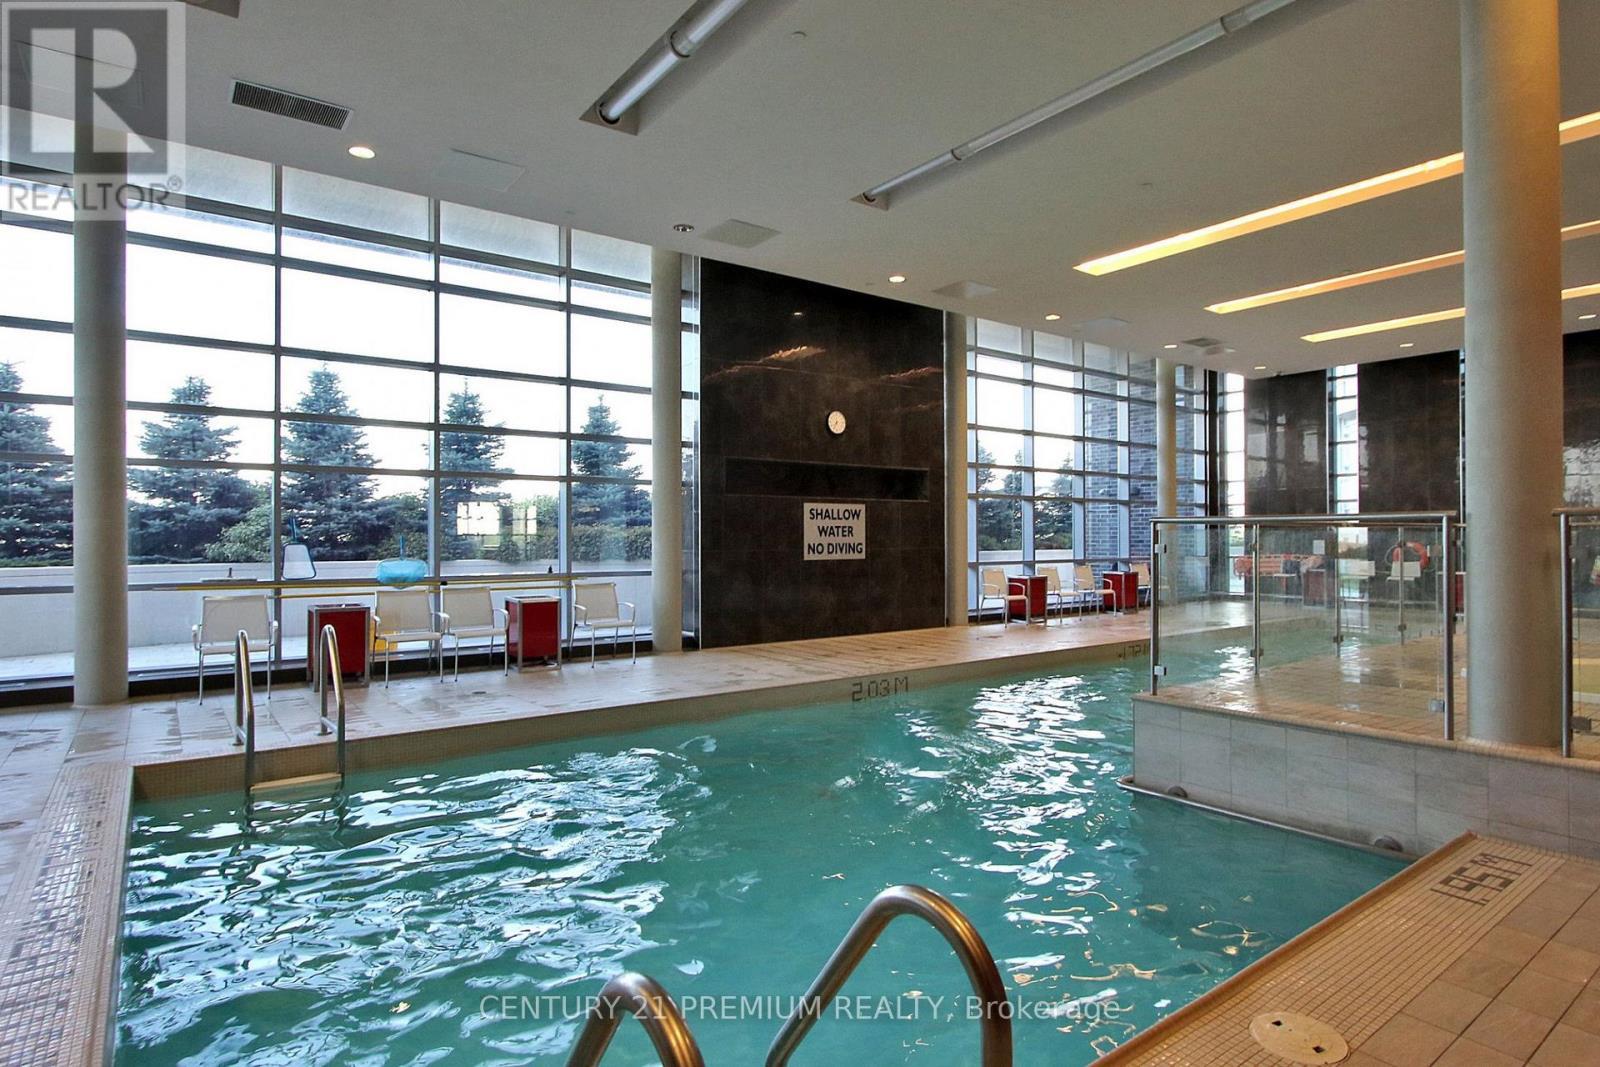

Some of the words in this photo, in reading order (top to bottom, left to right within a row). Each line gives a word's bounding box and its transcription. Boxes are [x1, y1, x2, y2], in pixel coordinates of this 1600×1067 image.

[809, 508, 861, 520] SHALLOW
[817, 525, 854, 538] WATER
[807, 543, 824, 555] NO
[827, 543, 863, 554] DIVING
